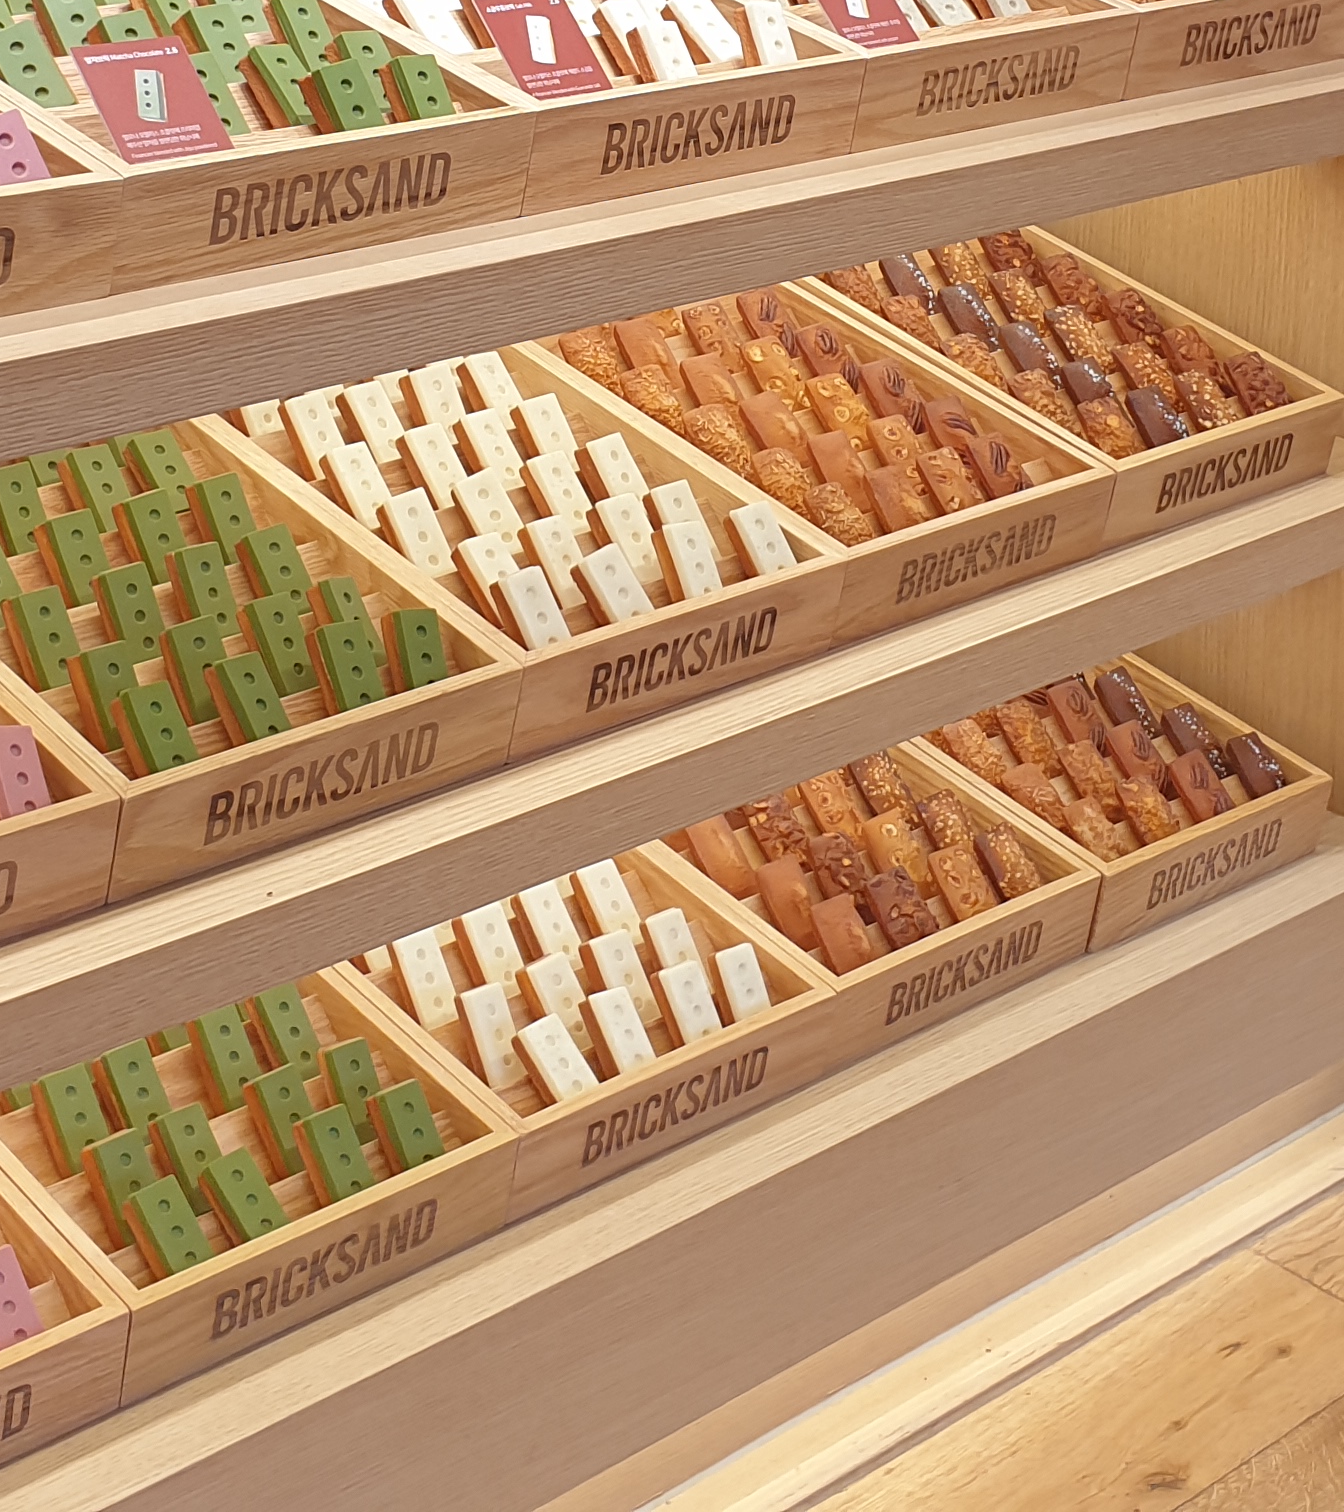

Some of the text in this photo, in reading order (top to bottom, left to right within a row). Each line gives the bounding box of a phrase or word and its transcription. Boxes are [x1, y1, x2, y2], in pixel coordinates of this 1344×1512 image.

[916, 45, 1079, 118] BRICKSAND
[1179, 4, 1322, 66] BRICKSAND
[600, 94, 795, 175] BRICKSAND
[209, 152, 450, 246] BRICKSAND
[1156, 433, 1294, 513] BRICKSAND
[896, 514, 1057, 603] BRICKSAND
[585, 607, 778, 713] BRICKSAND
[204, 722, 438, 845] BRICKSAND
[1147, 819, 1282, 911] BRICKSAND
[885, 920, 1043, 1026] BRICKSAND
[581, 1046, 769, 1168] BRICKSAND
[212, 1198, 437, 1340] BRICKSAND
